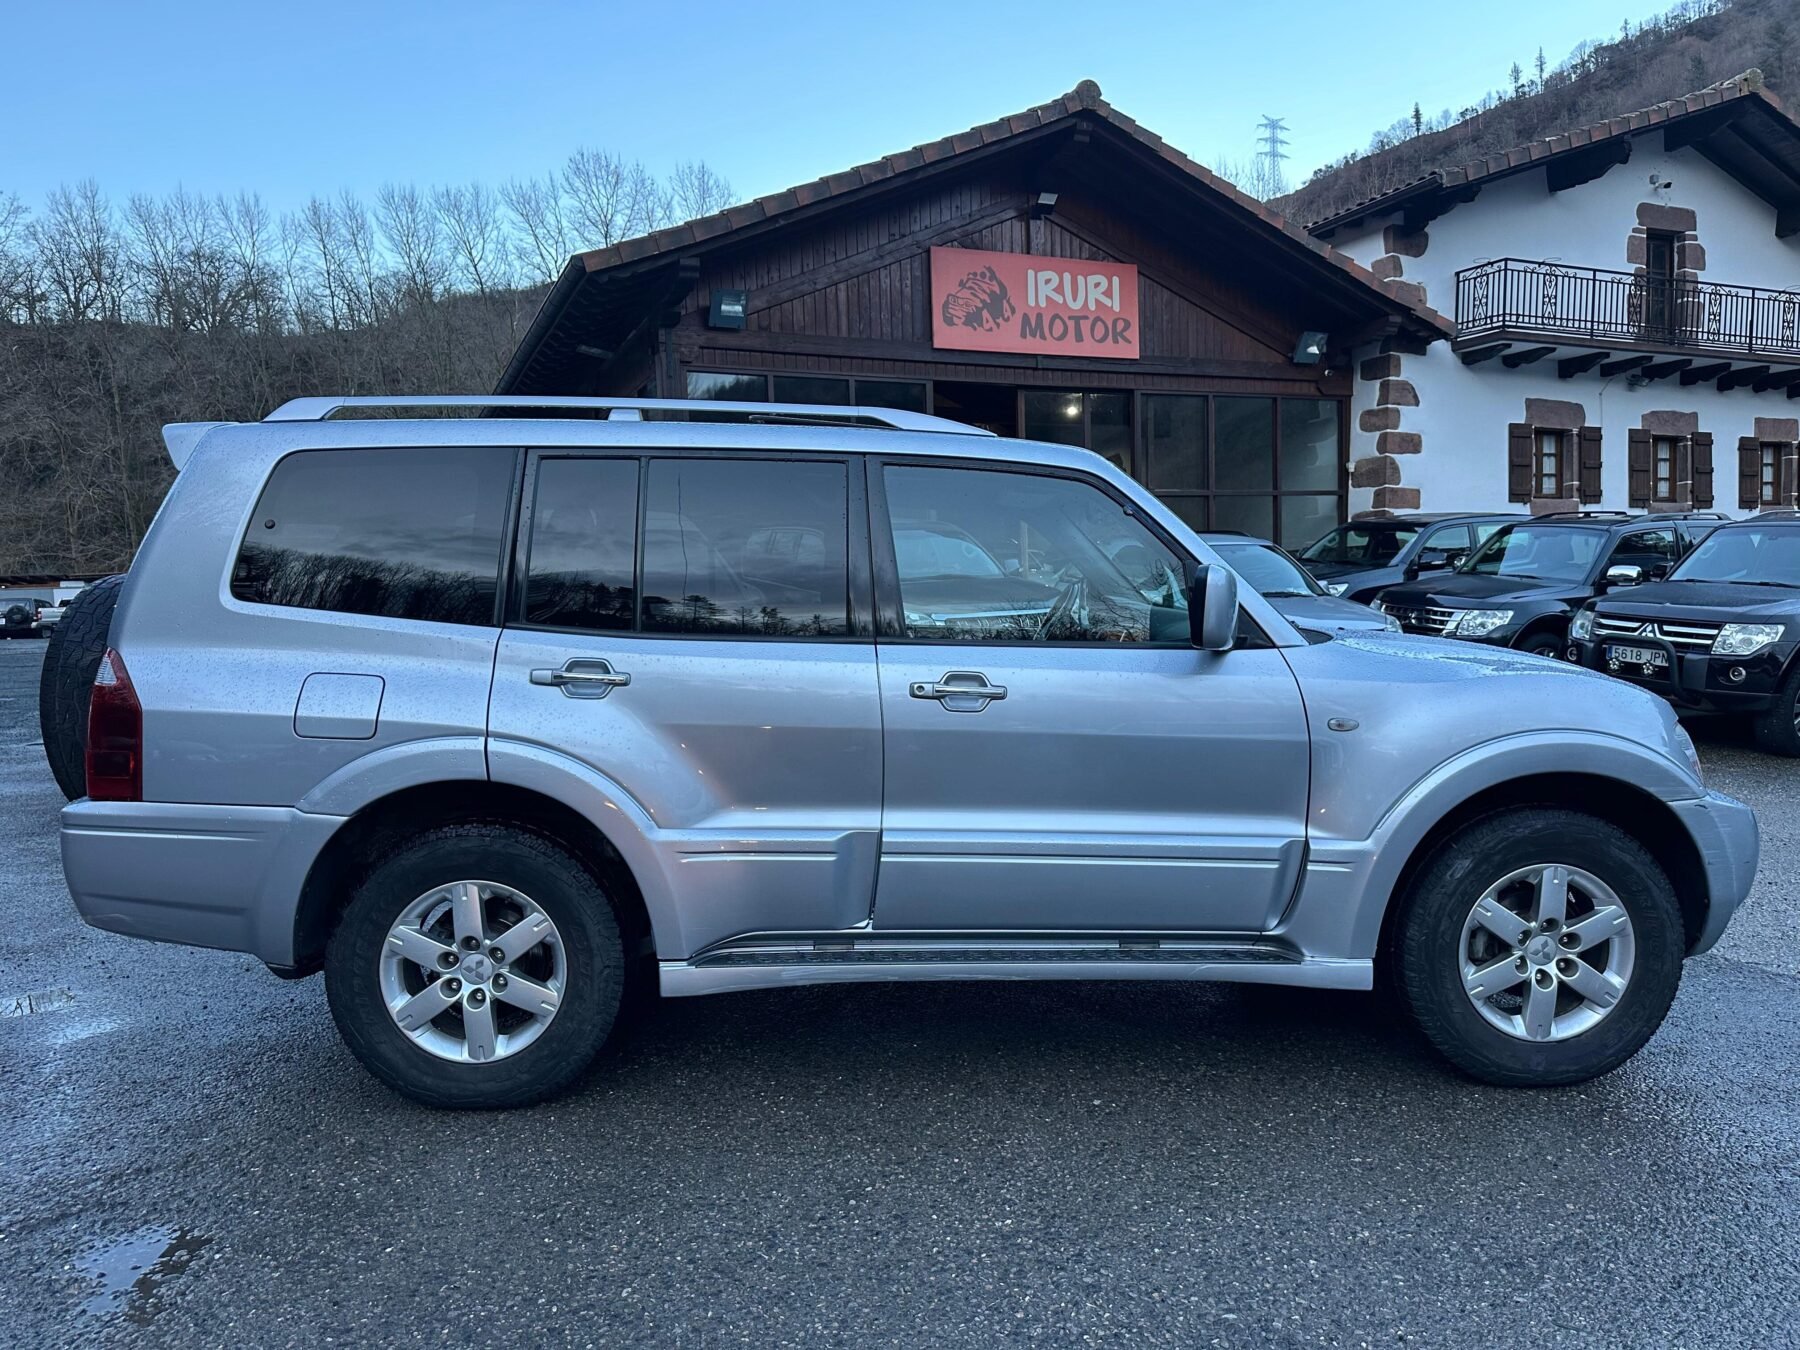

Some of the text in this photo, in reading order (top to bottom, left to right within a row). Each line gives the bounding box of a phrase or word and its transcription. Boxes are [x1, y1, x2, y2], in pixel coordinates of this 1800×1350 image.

[1027, 269, 1120, 312] IRURI
[1019, 312, 1132, 344] MOTOR
[1614, 647, 1642, 660] 5618
